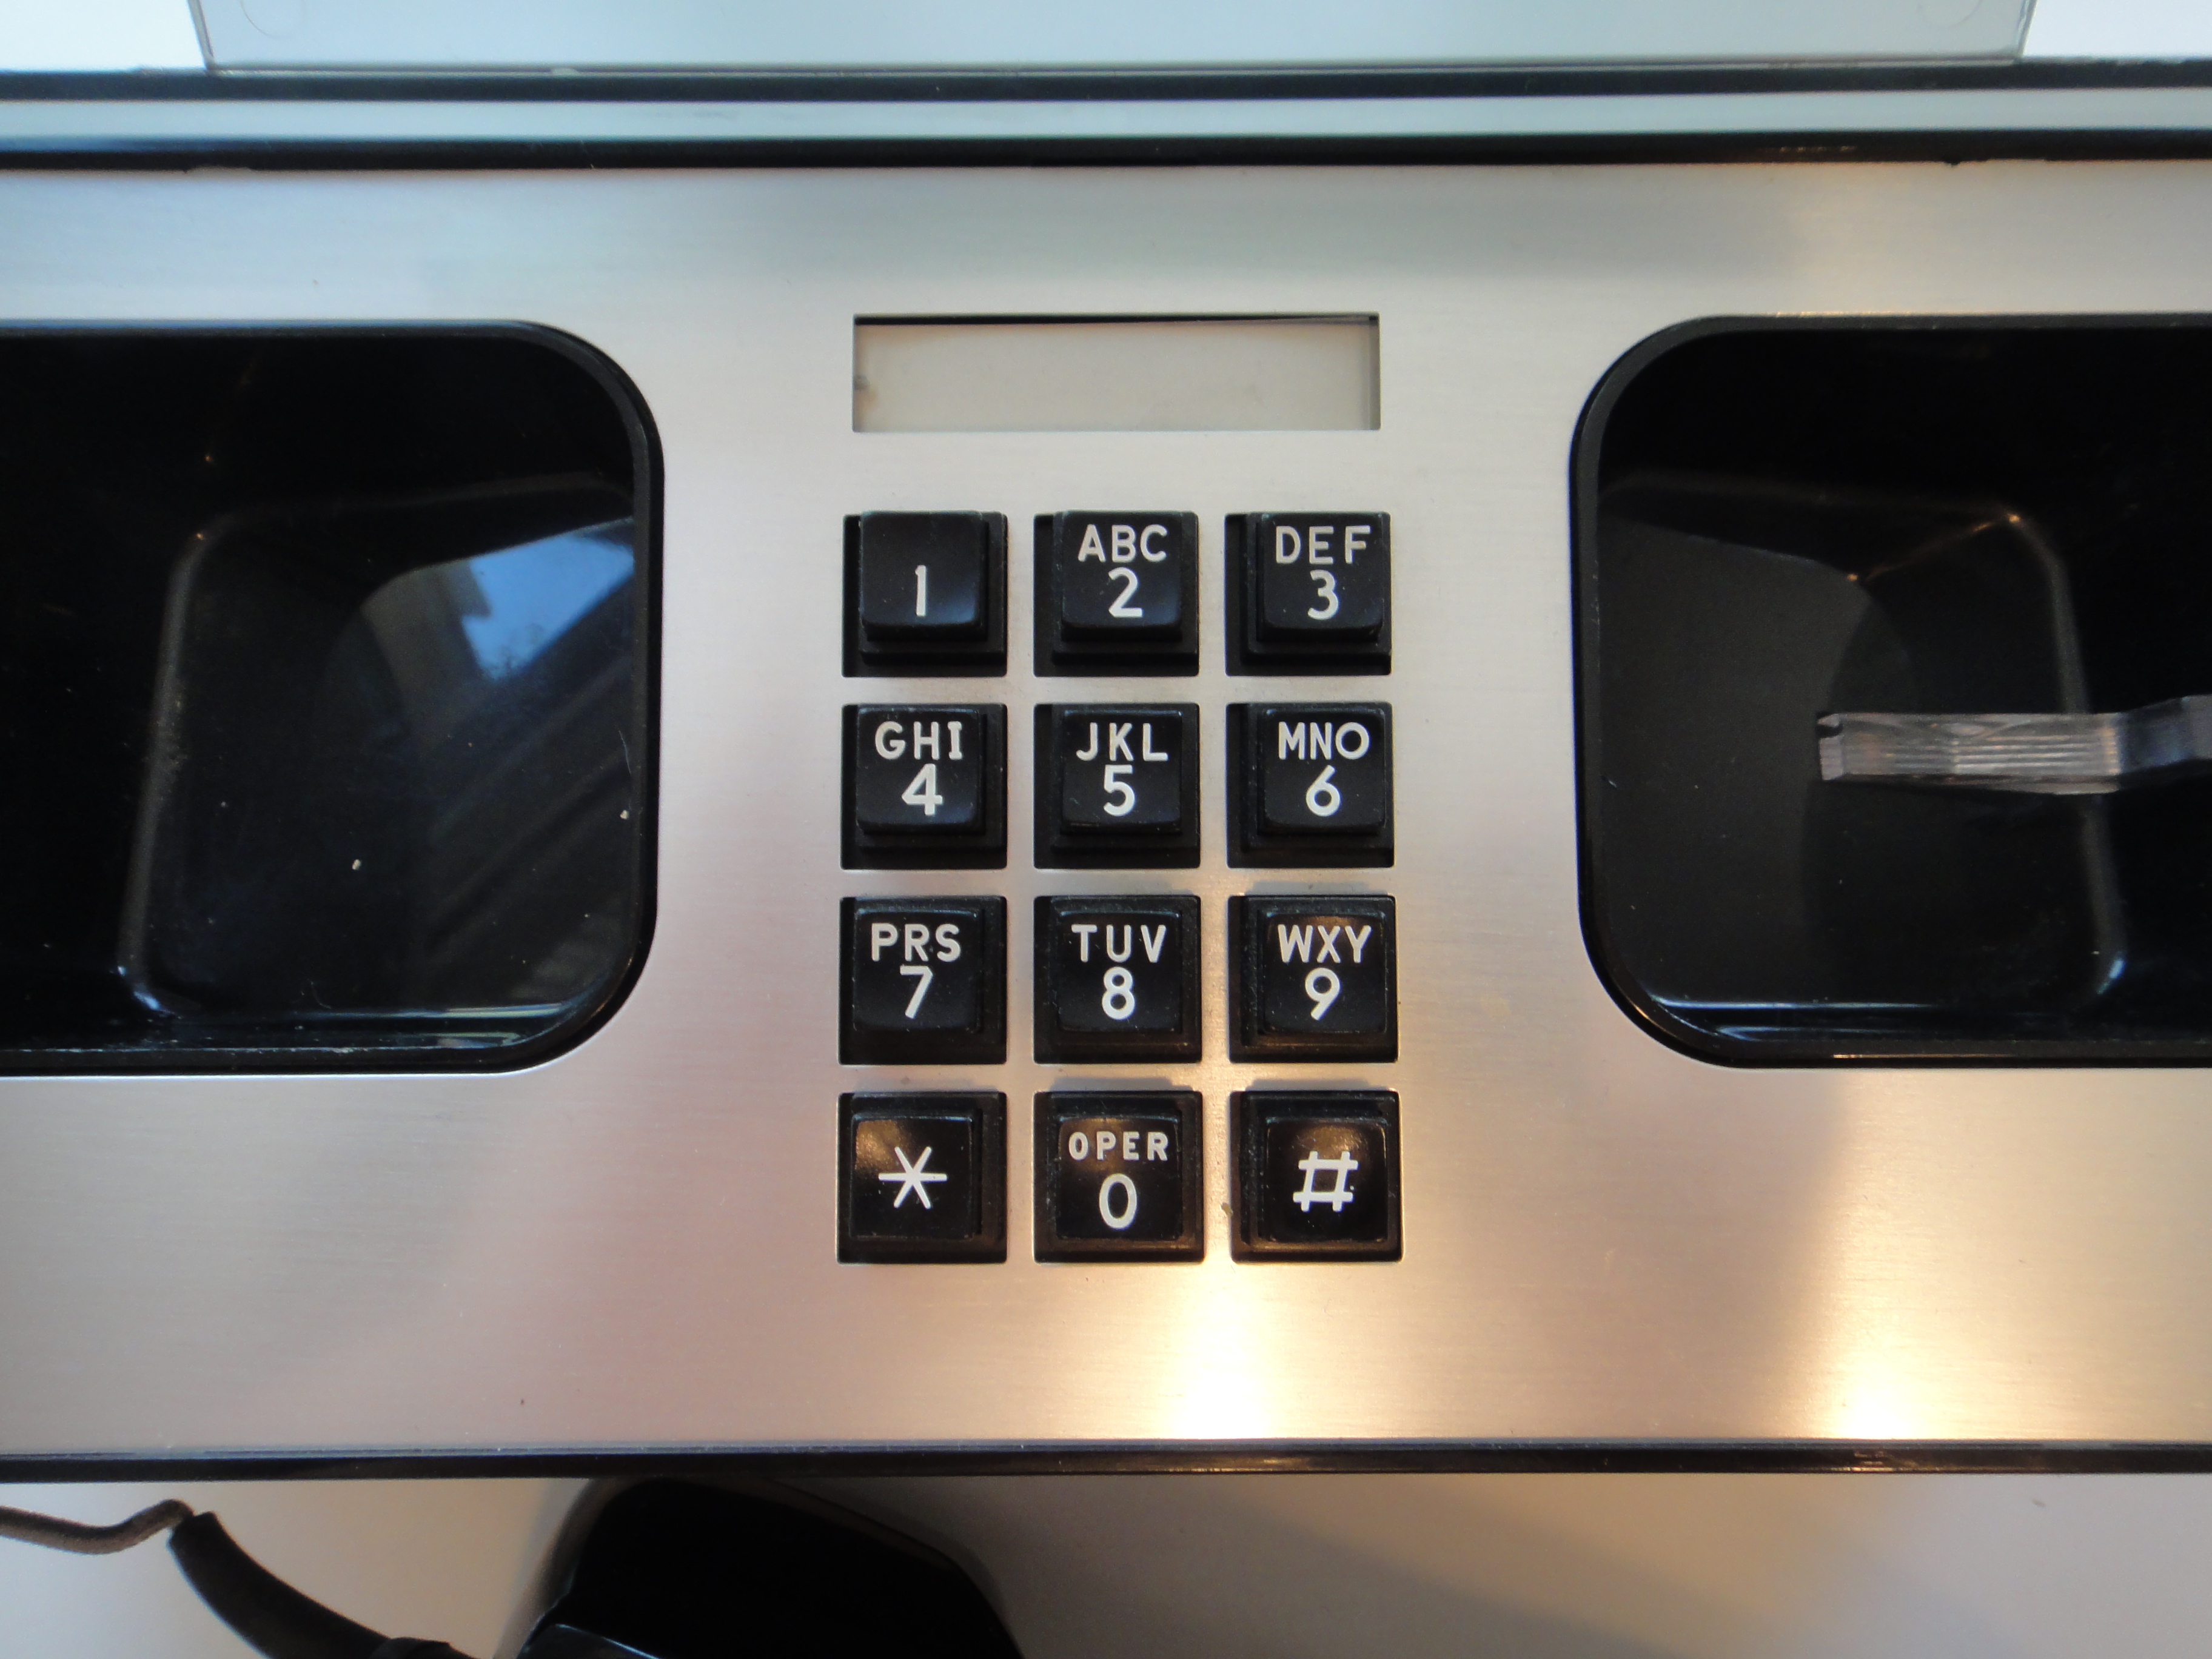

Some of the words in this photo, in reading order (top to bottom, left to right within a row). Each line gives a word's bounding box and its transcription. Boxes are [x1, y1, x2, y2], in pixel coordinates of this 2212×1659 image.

[1077, 523, 1168, 563] ABC
[1275, 525, 1371, 565] DEF
[914, 564, 927, 617] 1
[1107, 566, 1144, 618] 2
[1307, 569, 1339, 620] 3
[874, 720, 963, 761] GHI
[1076, 722, 1168, 762] JKL
[1278, 721, 1370, 760] MNO
[900, 762, 943, 817] 4
[1102, 763, 1136, 817] 5
[1305, 764, 1341, 817] 6
[871, 922, 962, 963] PRS
[1070, 923, 1167, 964] TUV
[1277, 923, 1372, 964] WXY
[899, 964, 934, 1019] 7
[1101, 966, 1136, 1021] 8
[1304, 967, 1341, 1021] 9
[1068, 1131, 1169, 1161] OPER
